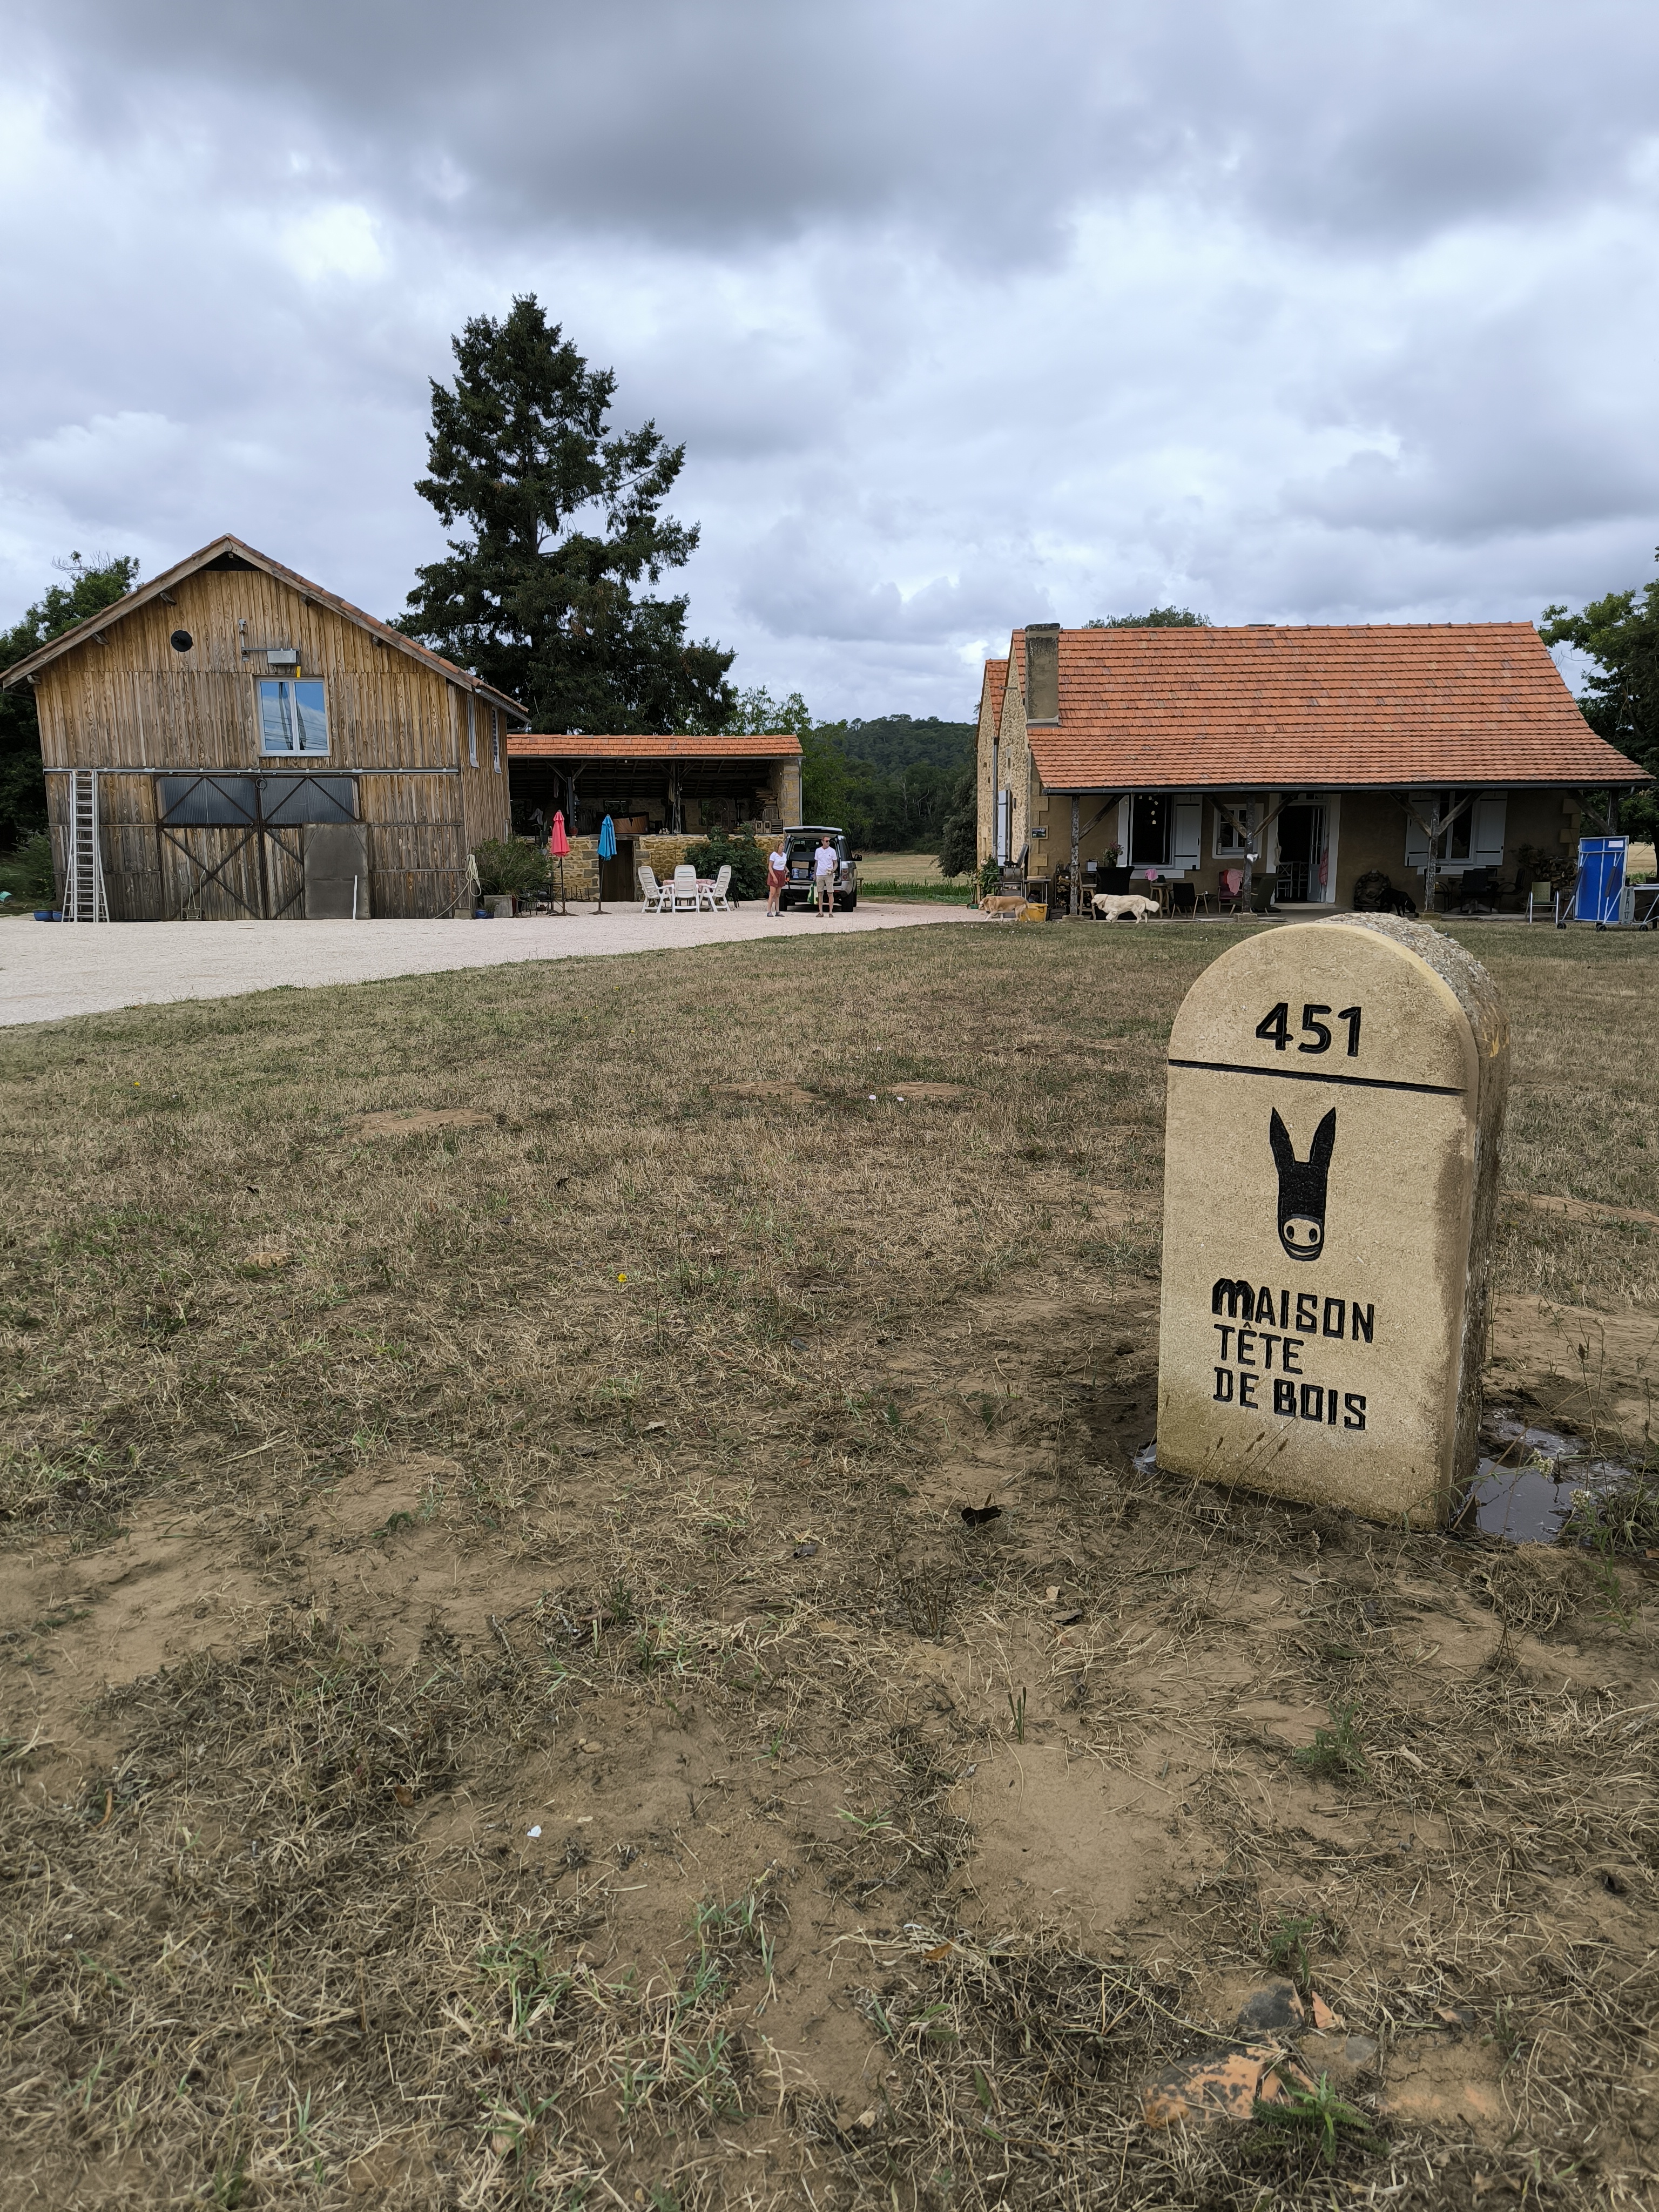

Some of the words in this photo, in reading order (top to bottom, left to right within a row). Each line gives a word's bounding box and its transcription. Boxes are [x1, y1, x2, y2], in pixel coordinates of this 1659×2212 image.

[1255, 1002, 1363, 1057] 451
[1211, 1278, 1375, 1344] MAISON
[1213, 1322, 1304, 1375] TÊTE
[1212, 1366, 1259, 1410] DE
[1273, 1378, 1367, 1431] BOIS
